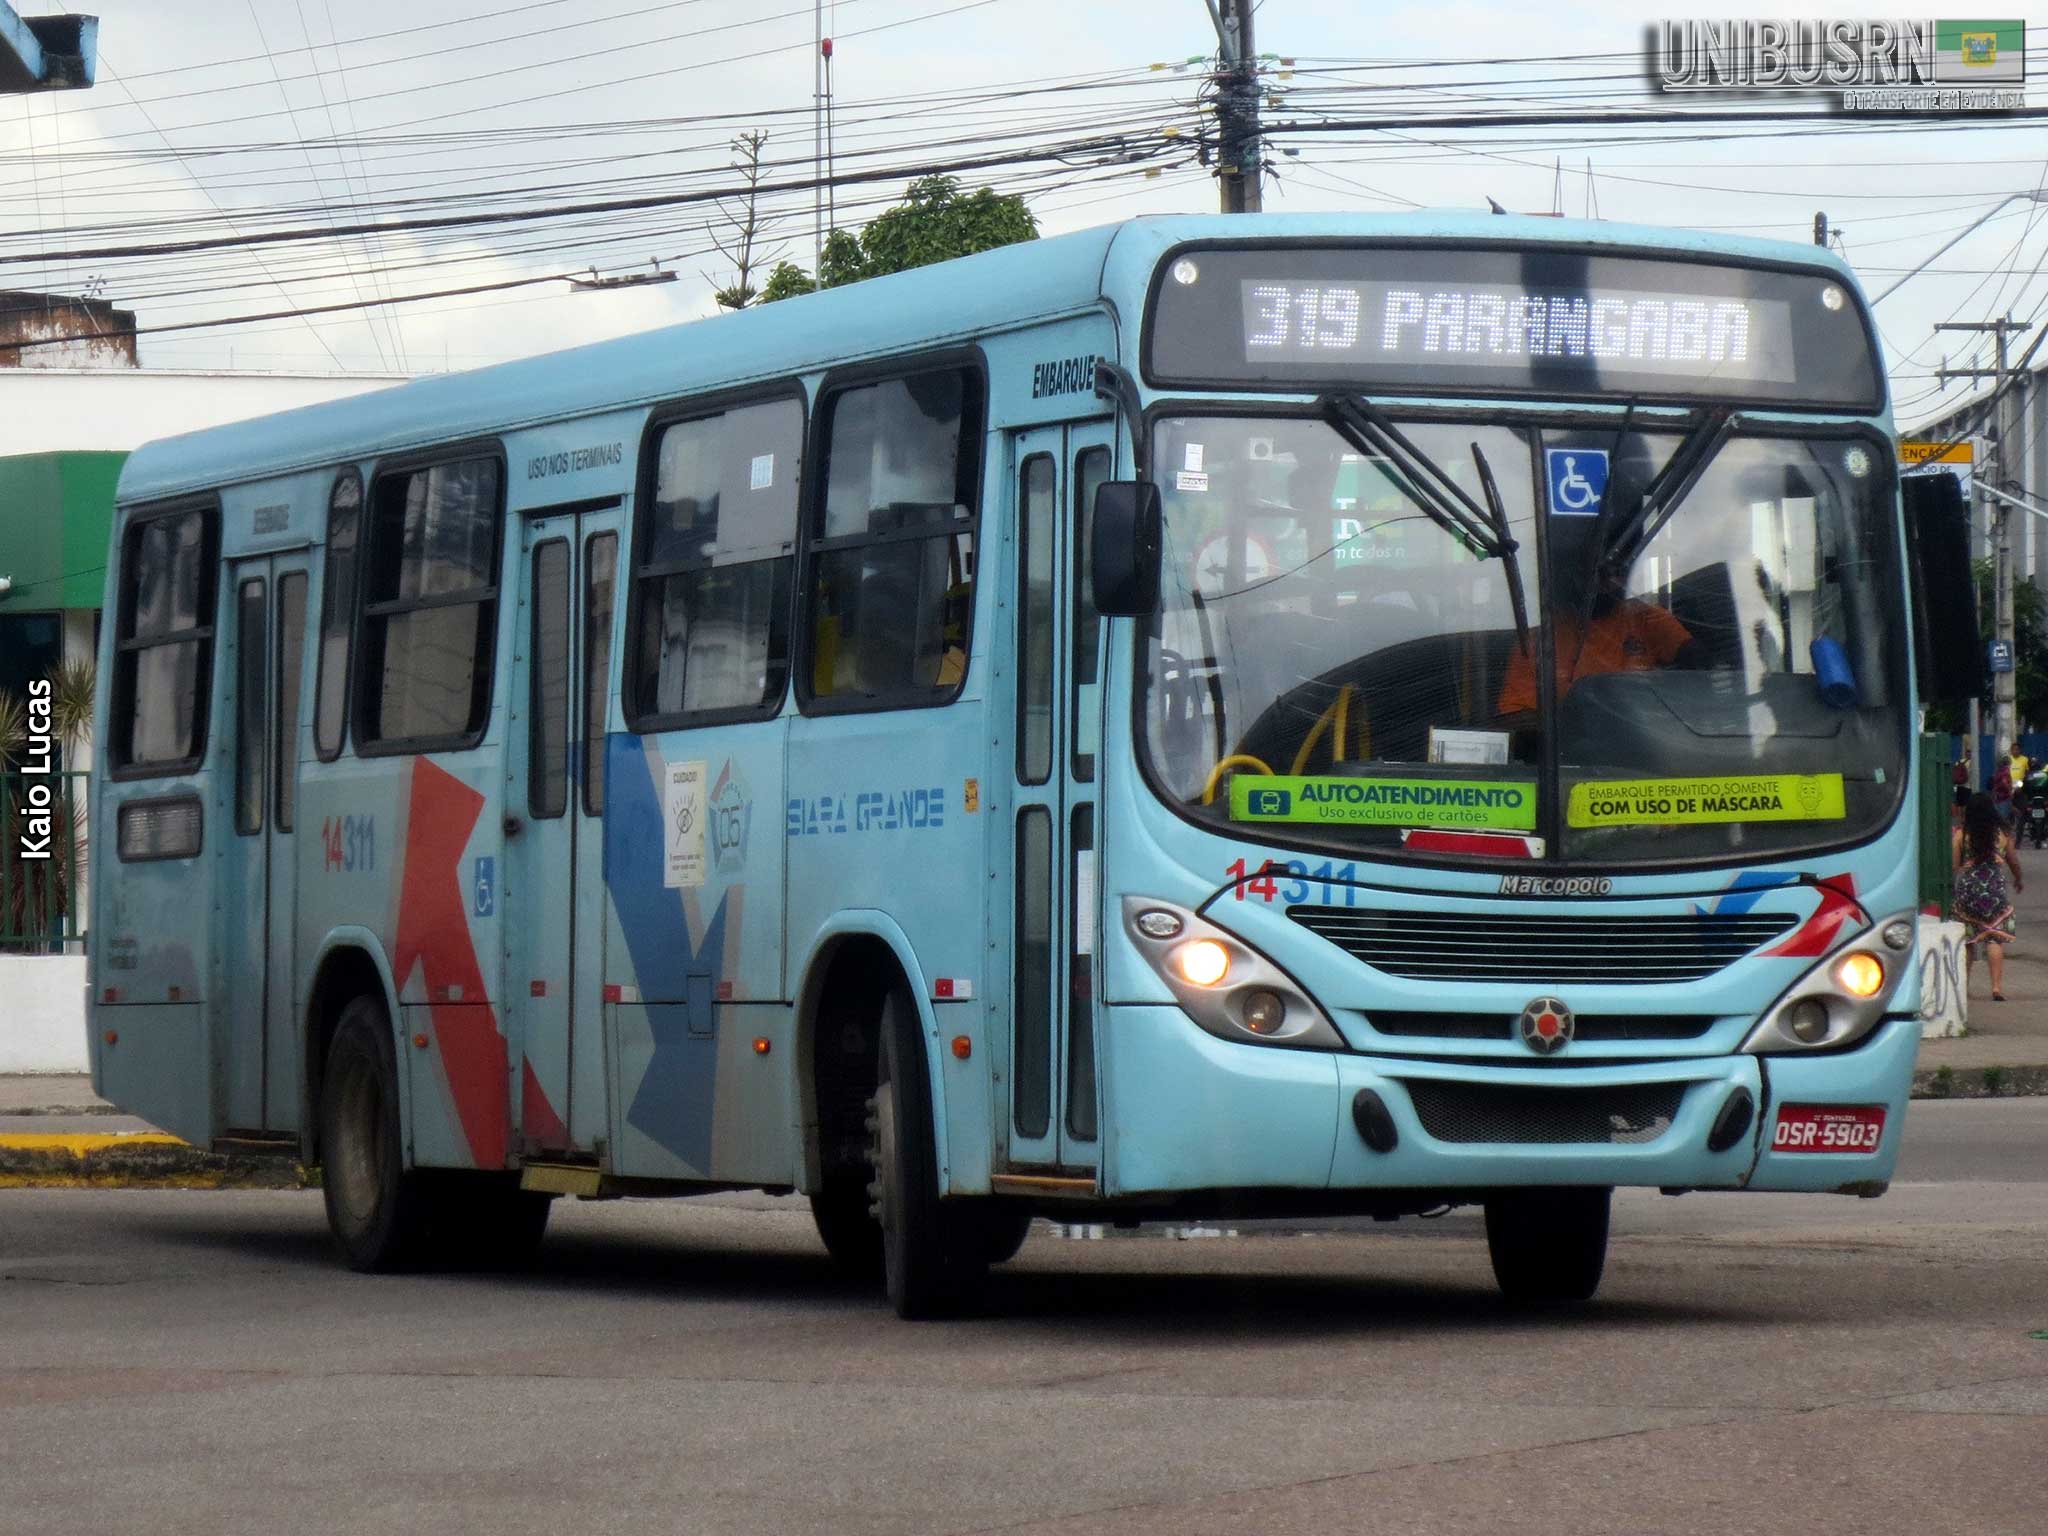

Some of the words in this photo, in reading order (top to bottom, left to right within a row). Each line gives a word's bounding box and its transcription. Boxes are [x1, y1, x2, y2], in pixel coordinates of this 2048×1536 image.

[1248, 286, 1359, 348] 319
[1382, 290, 1750, 361] PARANGABA
[1032, 354, 1095, 399] EMBARQUE
[528, 456, 547, 480] USO
[548, 453, 569, 476] NOS
[571, 442, 622, 472] TERMINAIS
[1300, 783, 1523, 808] AUTOATENDIMENTO
[1589, 784, 1654, 800] EMBARQUE
[1658, 783, 1720, 797] PERMITIDO
[1724, 781, 1779, 795] SOMENTE
[1590, 801, 1630, 816] COM
[1636, 799, 1671, 814] USO
[1677, 798, 1696, 813] DE
[1702, 794, 1782, 813] MÁSCARA
[856, 788, 944, 831] GRANDE
[1319, 806, 1345, 818] Uso
[1349, 807, 1411, 820] exclusivo
[1417, 808, 1434, 820] de
[1438, 809, 1488, 822] cartões
[322, 815, 374, 872] 14311
[1226, 858, 1356, 906] 14311
[1500, 874, 1611, 895] Marcopolo
[1774, 1122, 1879, 1146] OSR-5903
